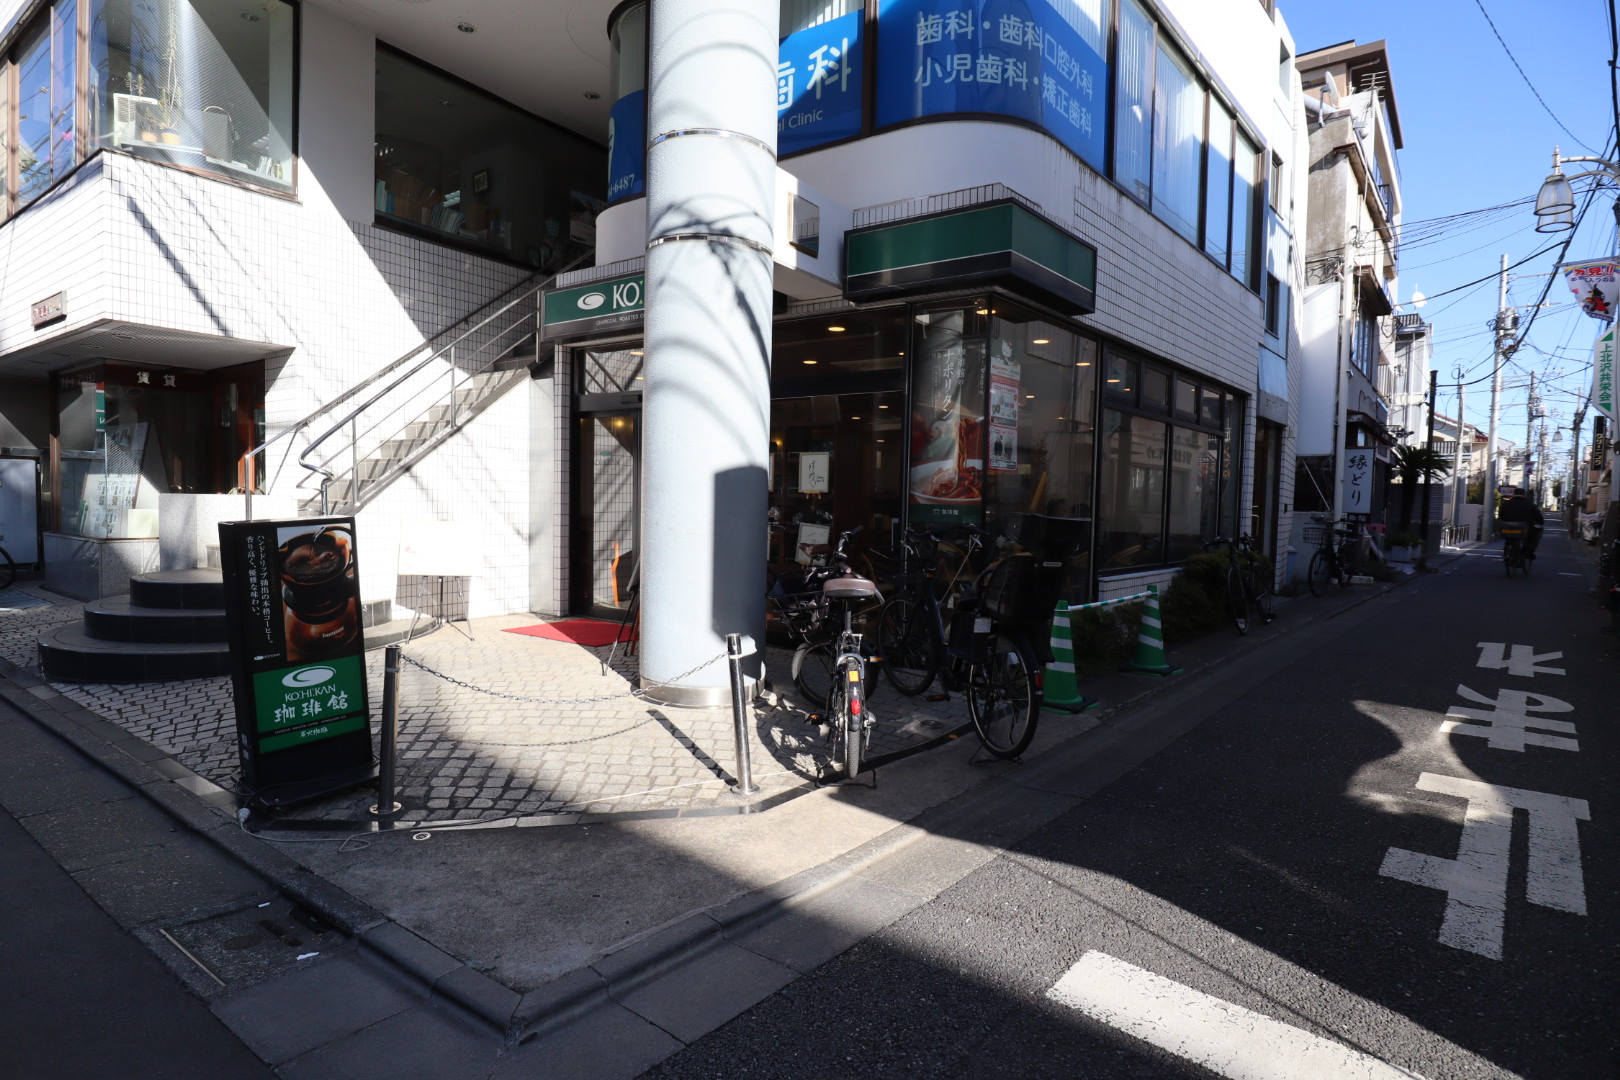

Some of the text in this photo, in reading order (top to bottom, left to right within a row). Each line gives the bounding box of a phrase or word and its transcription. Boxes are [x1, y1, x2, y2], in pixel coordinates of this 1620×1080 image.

[788, 109, 824, 129] Clinic
[942, 349, 954, 420] ナポリタン
[1599, 343, 1613, 402] 上北沢共栄会
[1348, 454, 1368, 506] 縁どり
[274, 690, 348, 724] 珈琲館
